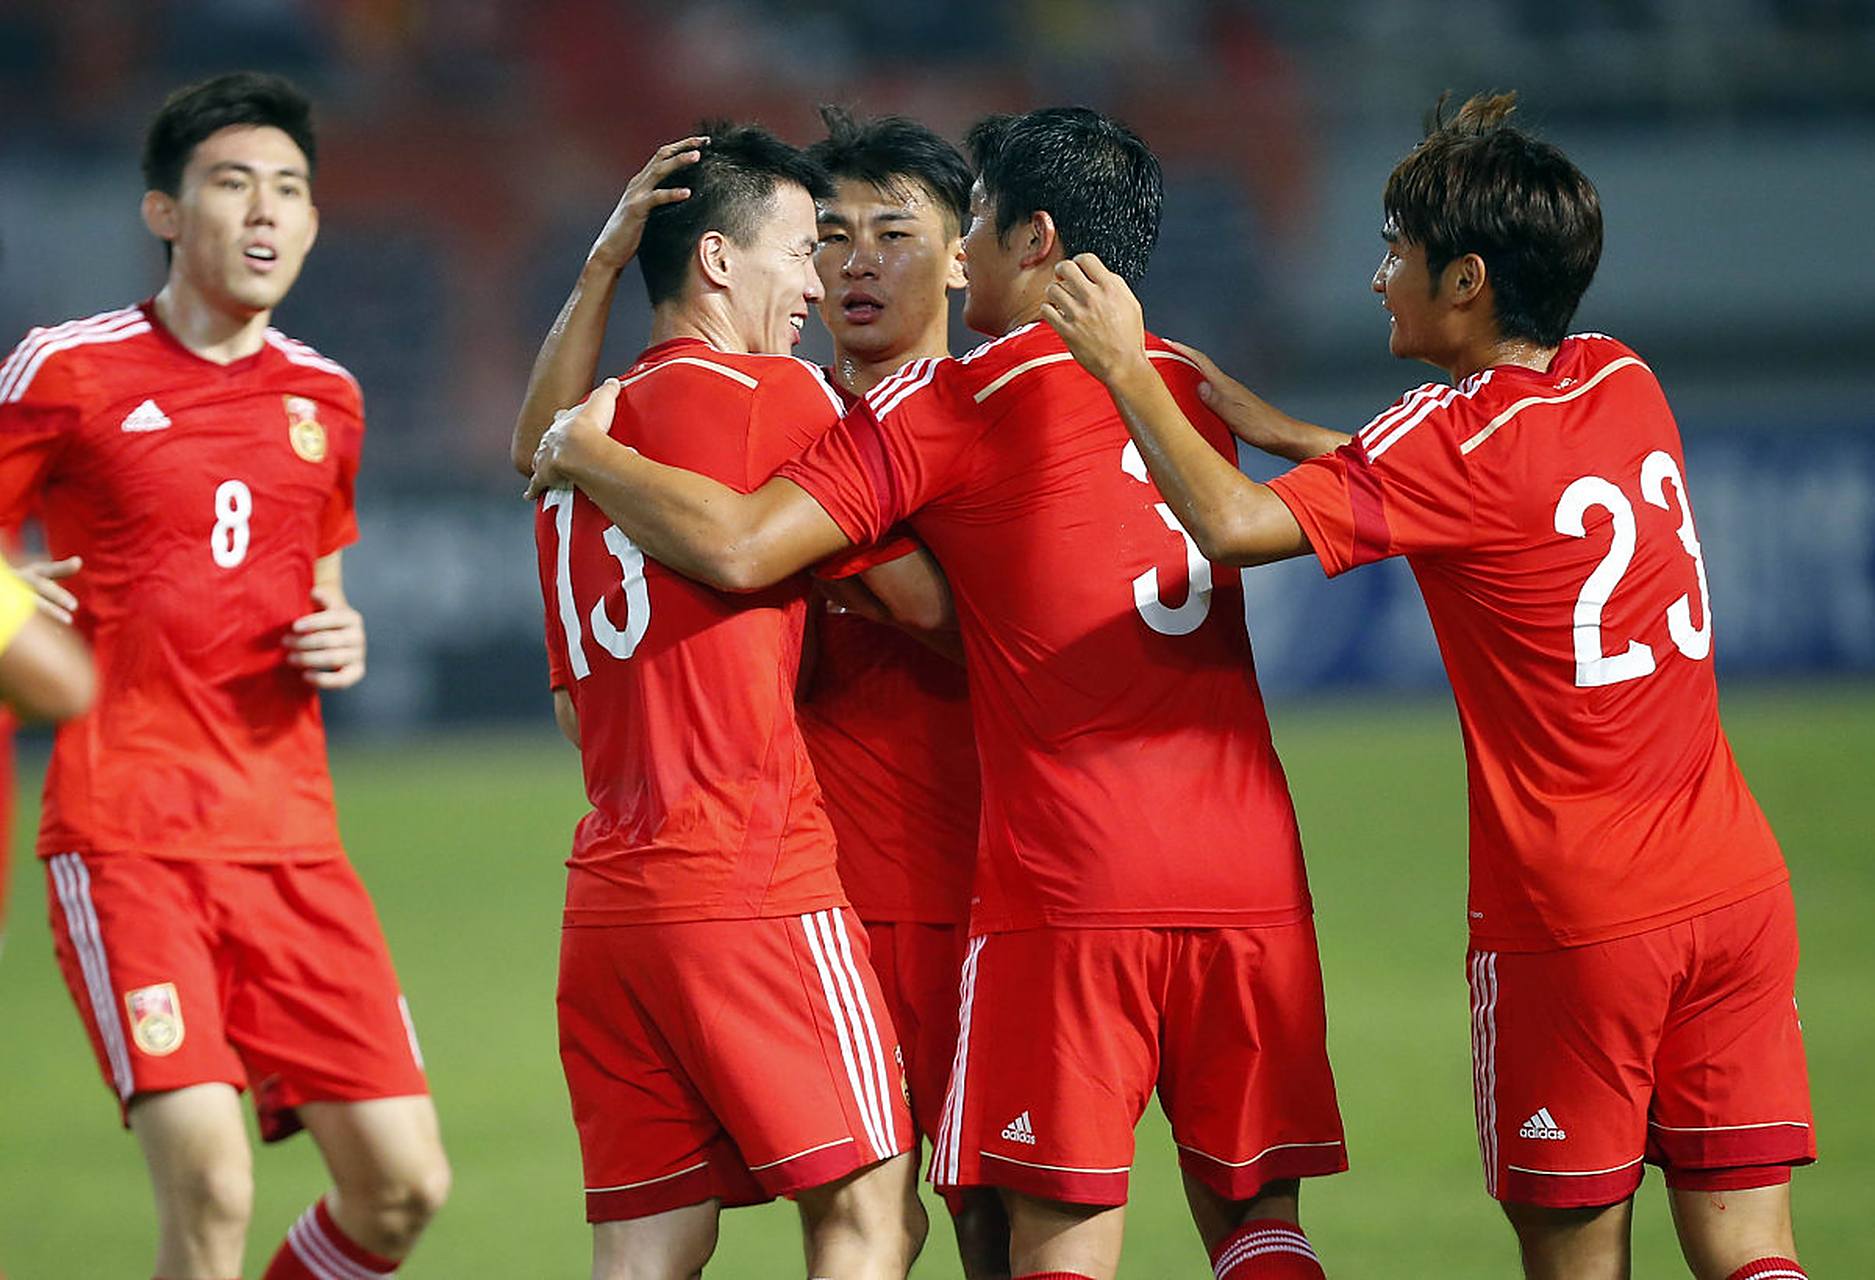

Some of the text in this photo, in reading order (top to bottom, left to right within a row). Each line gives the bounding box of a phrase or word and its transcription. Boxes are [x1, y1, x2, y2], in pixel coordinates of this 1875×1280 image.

[211, 479, 253, 569] 8
[1120, 437, 1214, 636] 3
[1554, 450, 1712, 687] 23
[1001, 1129, 1036, 1145] adidas
[1520, 1127, 1567, 1141] adidas
